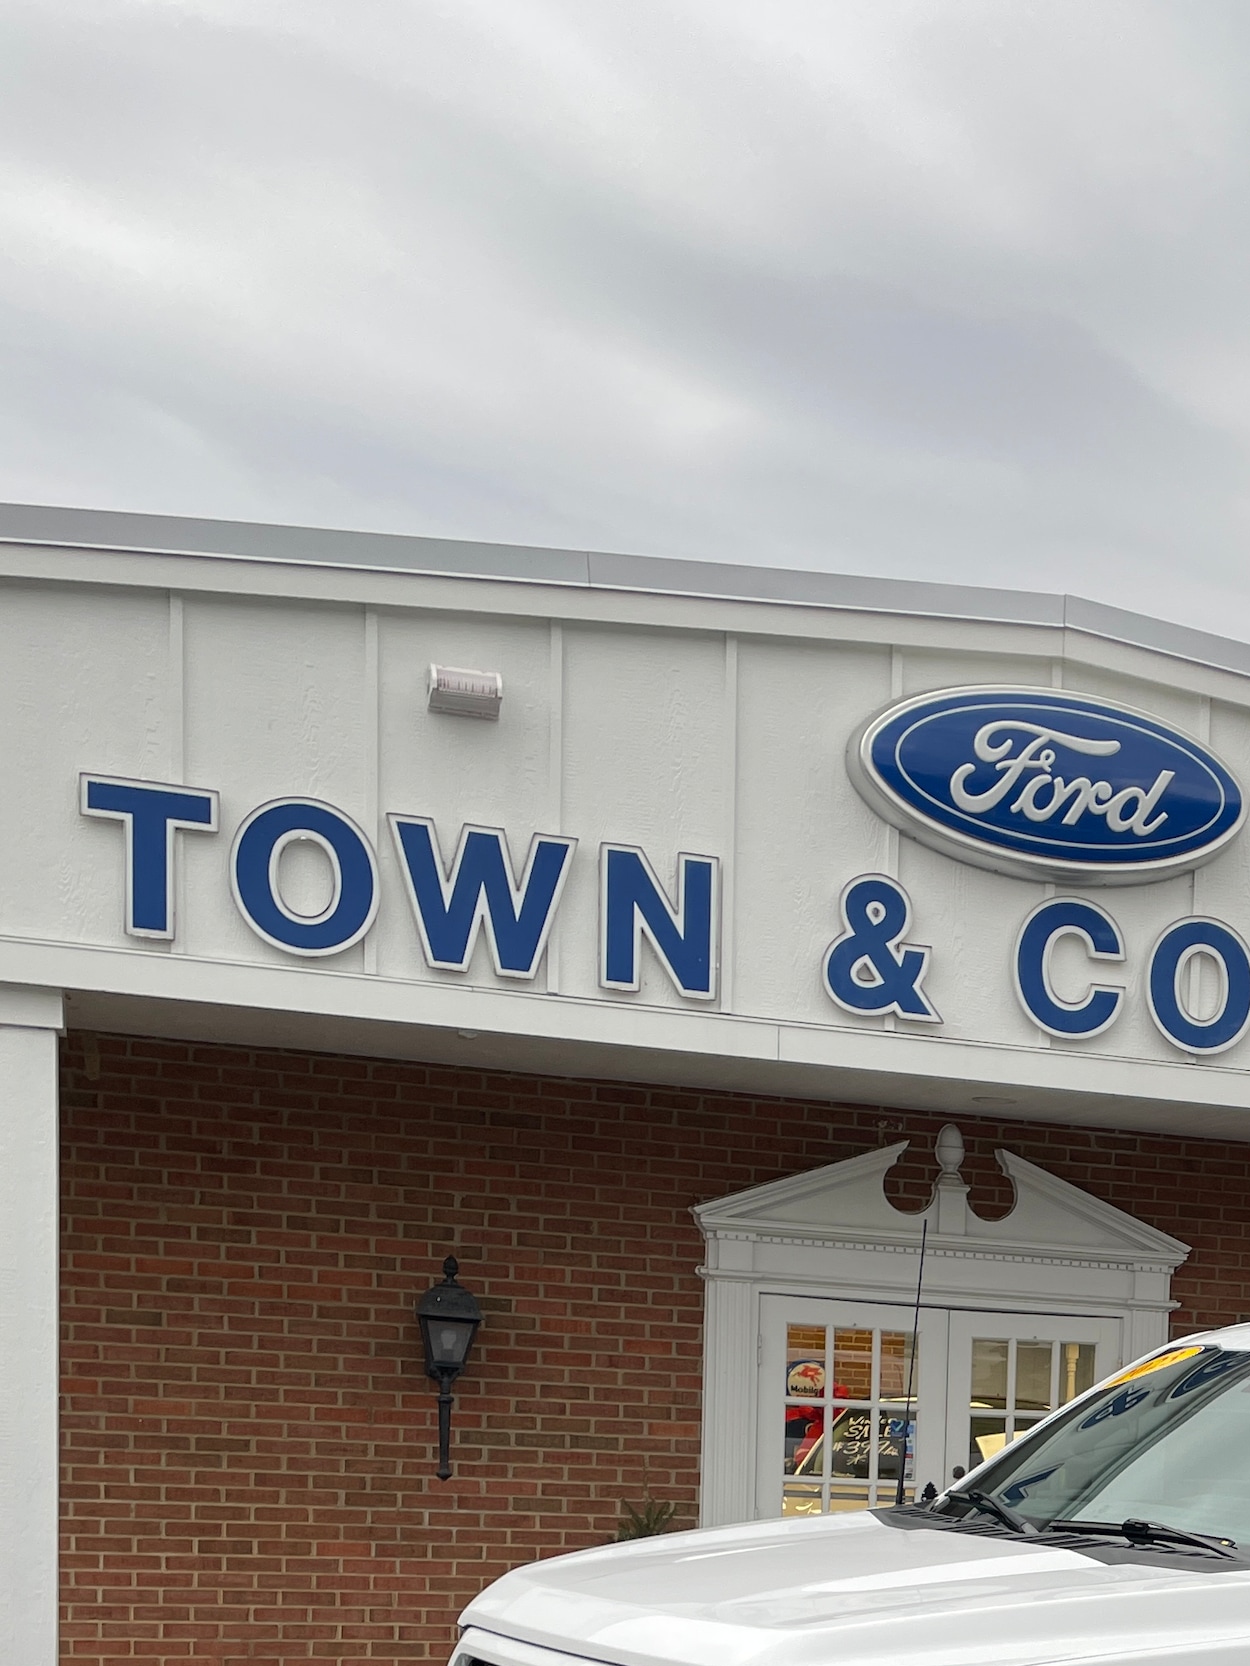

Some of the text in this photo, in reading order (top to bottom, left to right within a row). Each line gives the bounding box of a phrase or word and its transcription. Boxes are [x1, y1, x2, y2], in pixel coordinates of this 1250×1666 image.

[950, 720, 1175, 836] Ford
[79, 771, 719, 1000] TOWN
[822, 871, 944, 1025] &
